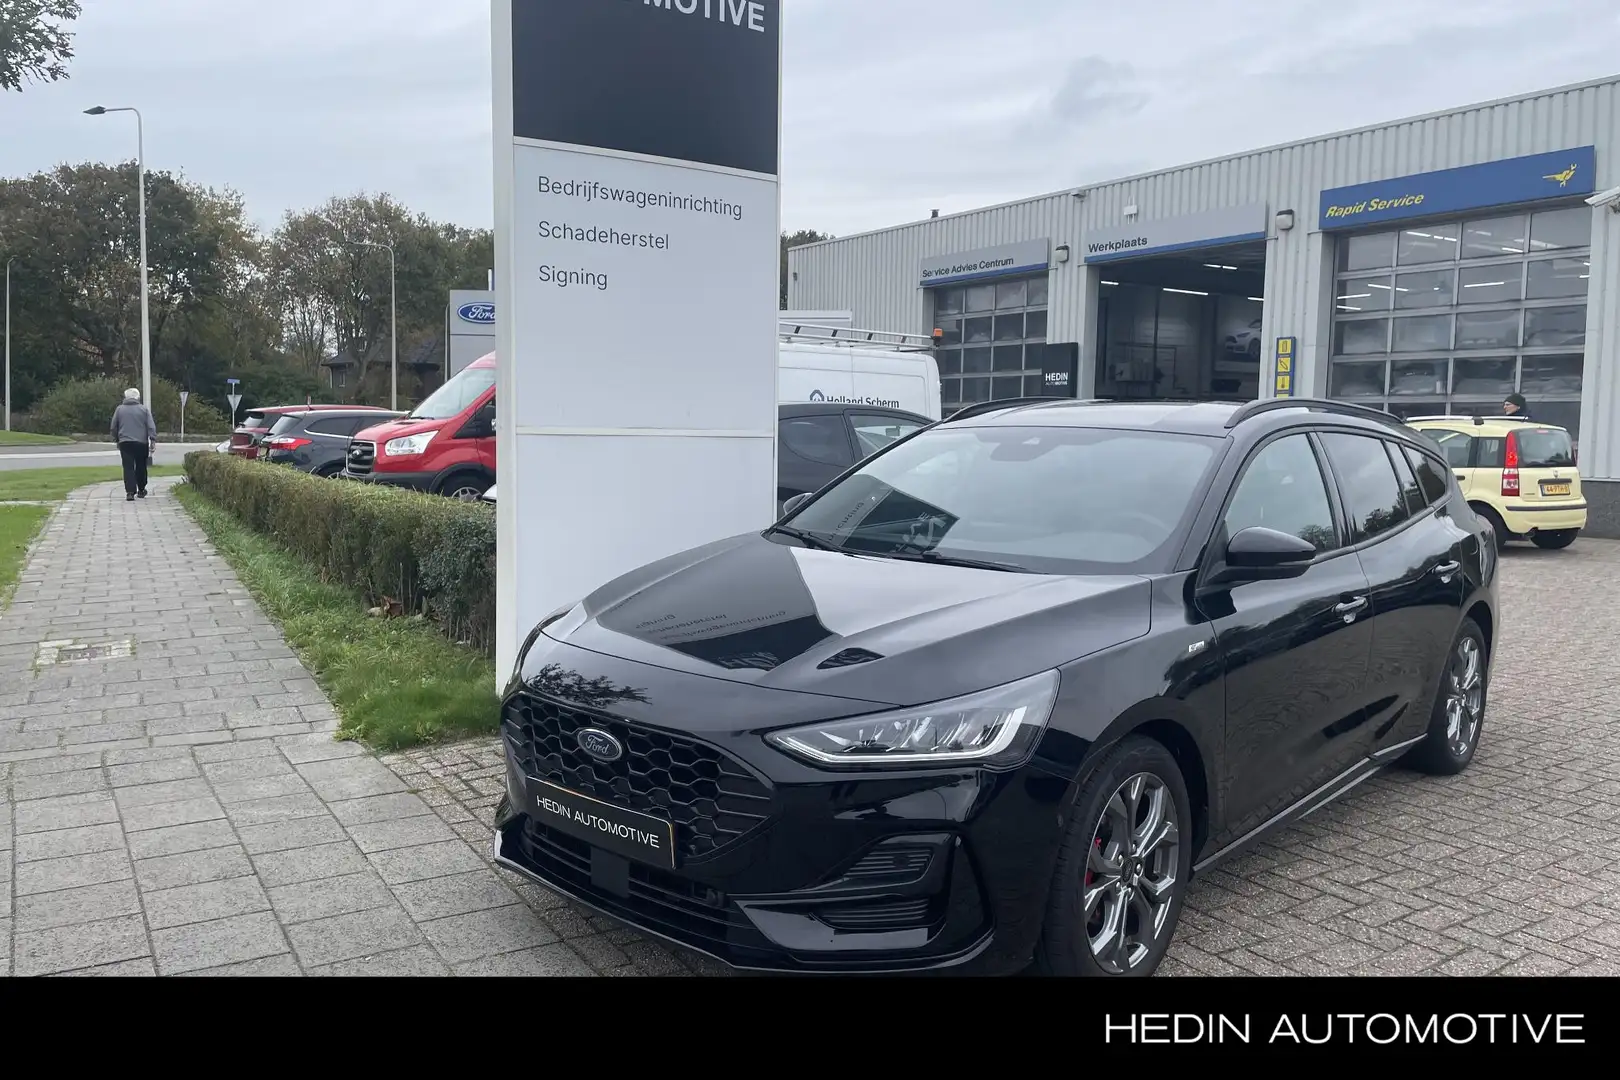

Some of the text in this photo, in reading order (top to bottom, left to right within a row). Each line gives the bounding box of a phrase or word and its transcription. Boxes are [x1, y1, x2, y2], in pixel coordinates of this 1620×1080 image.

[538, 175, 743, 221] Bedrijfswageninrichting
[1325, 194, 1425, 218] Rapid Service
[538, 220, 669, 250] Schadeherstel
[1088, 236, 1148, 252] Werkplaats
[538, 265, 608, 291] Signing
[922, 257, 1014, 278] Sevice Advies Centrum
[1045, 371, 1069, 382] HEDIN
[865, 396, 900, 409] Scherm
[536, 795, 660, 849] HEDIN AUTOMOTIVE
